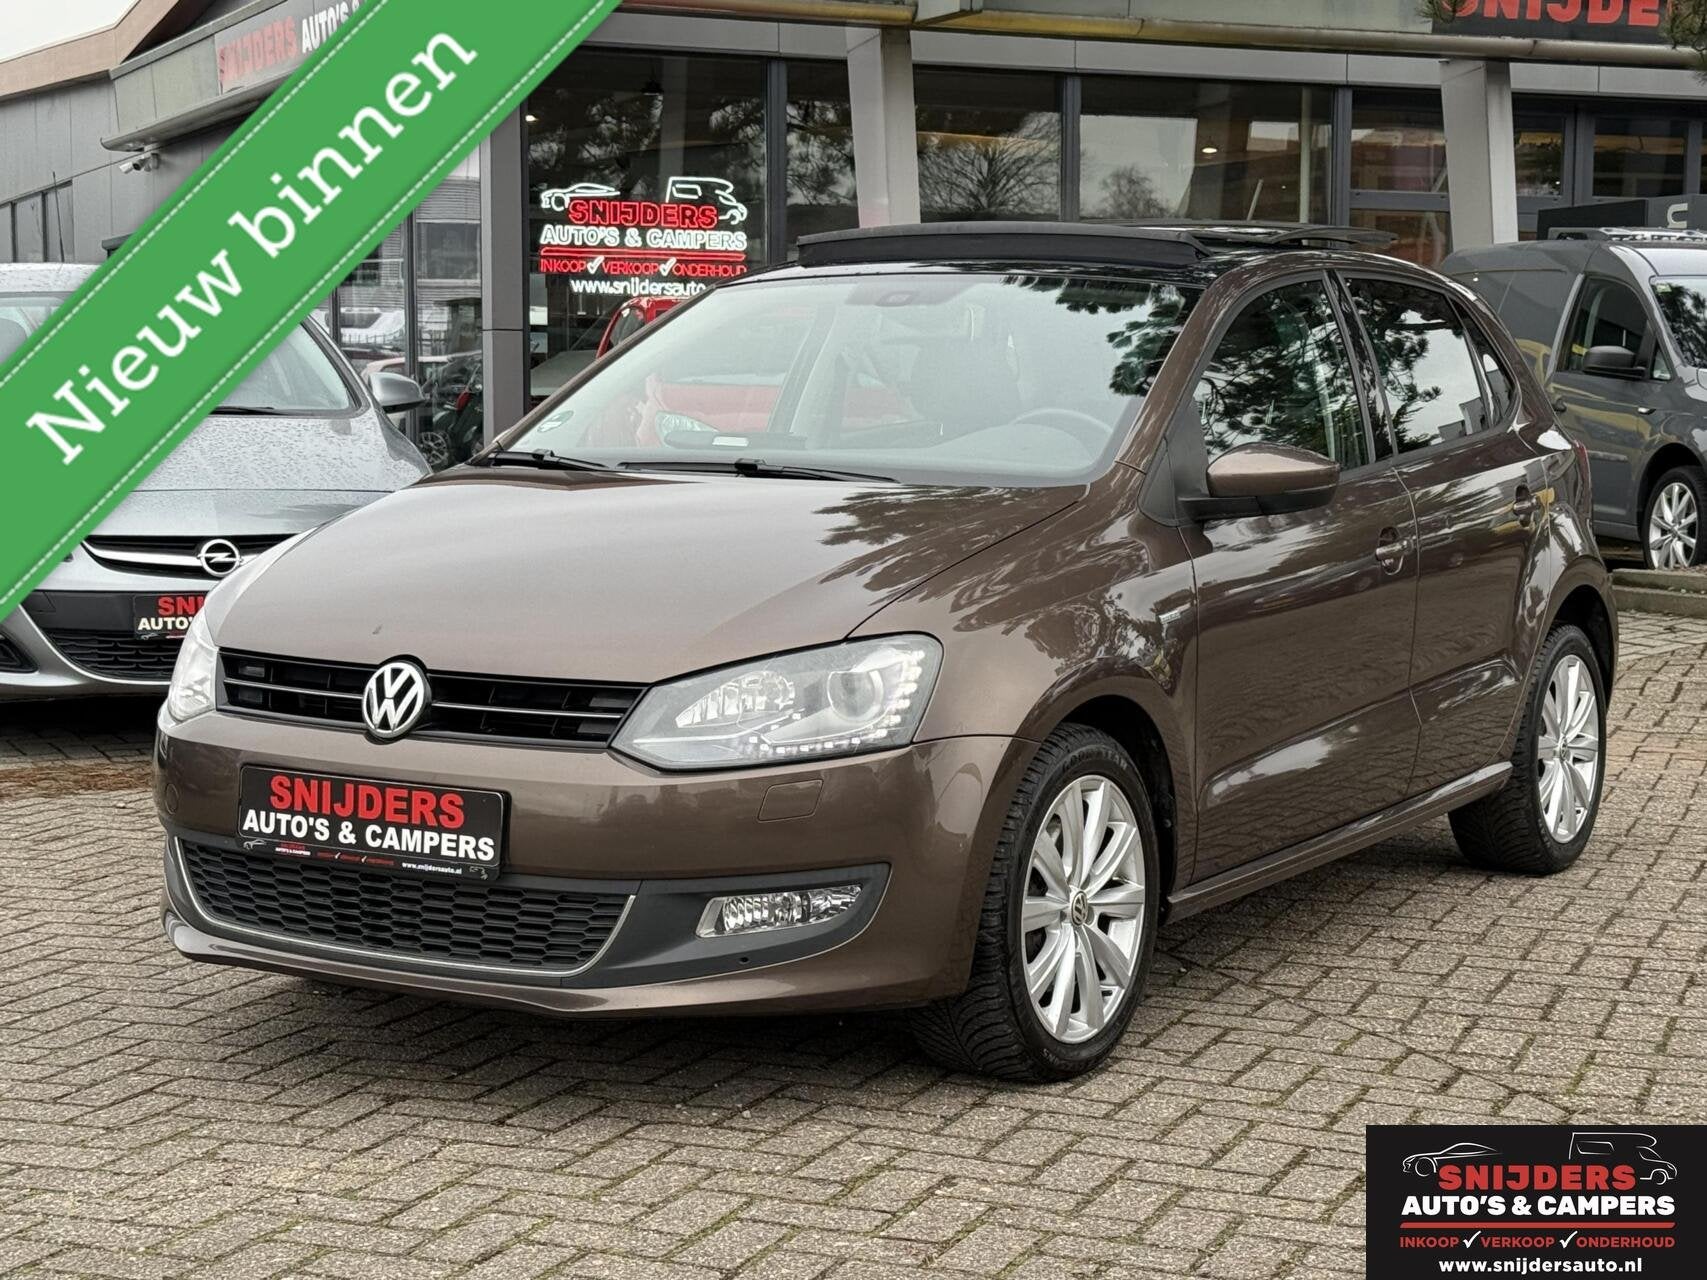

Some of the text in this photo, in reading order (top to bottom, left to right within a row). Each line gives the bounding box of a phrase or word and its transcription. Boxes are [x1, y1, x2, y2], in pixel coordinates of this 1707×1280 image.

[1440, 0, 1674, 27] NIJDE
[568, 199, 719, 229] SNIJDERS
[539, 224, 748, 252] AUTO'S & CAMPERS
[540, 258, 748, 277] INKOOP VERKOOP ONDERHOUD
[269, 775, 466, 829] SNIJDERS
[242, 809, 330, 842] AUTO'S
[338, 821, 357, 845] &
[365, 824, 495, 862] CAMPERS
